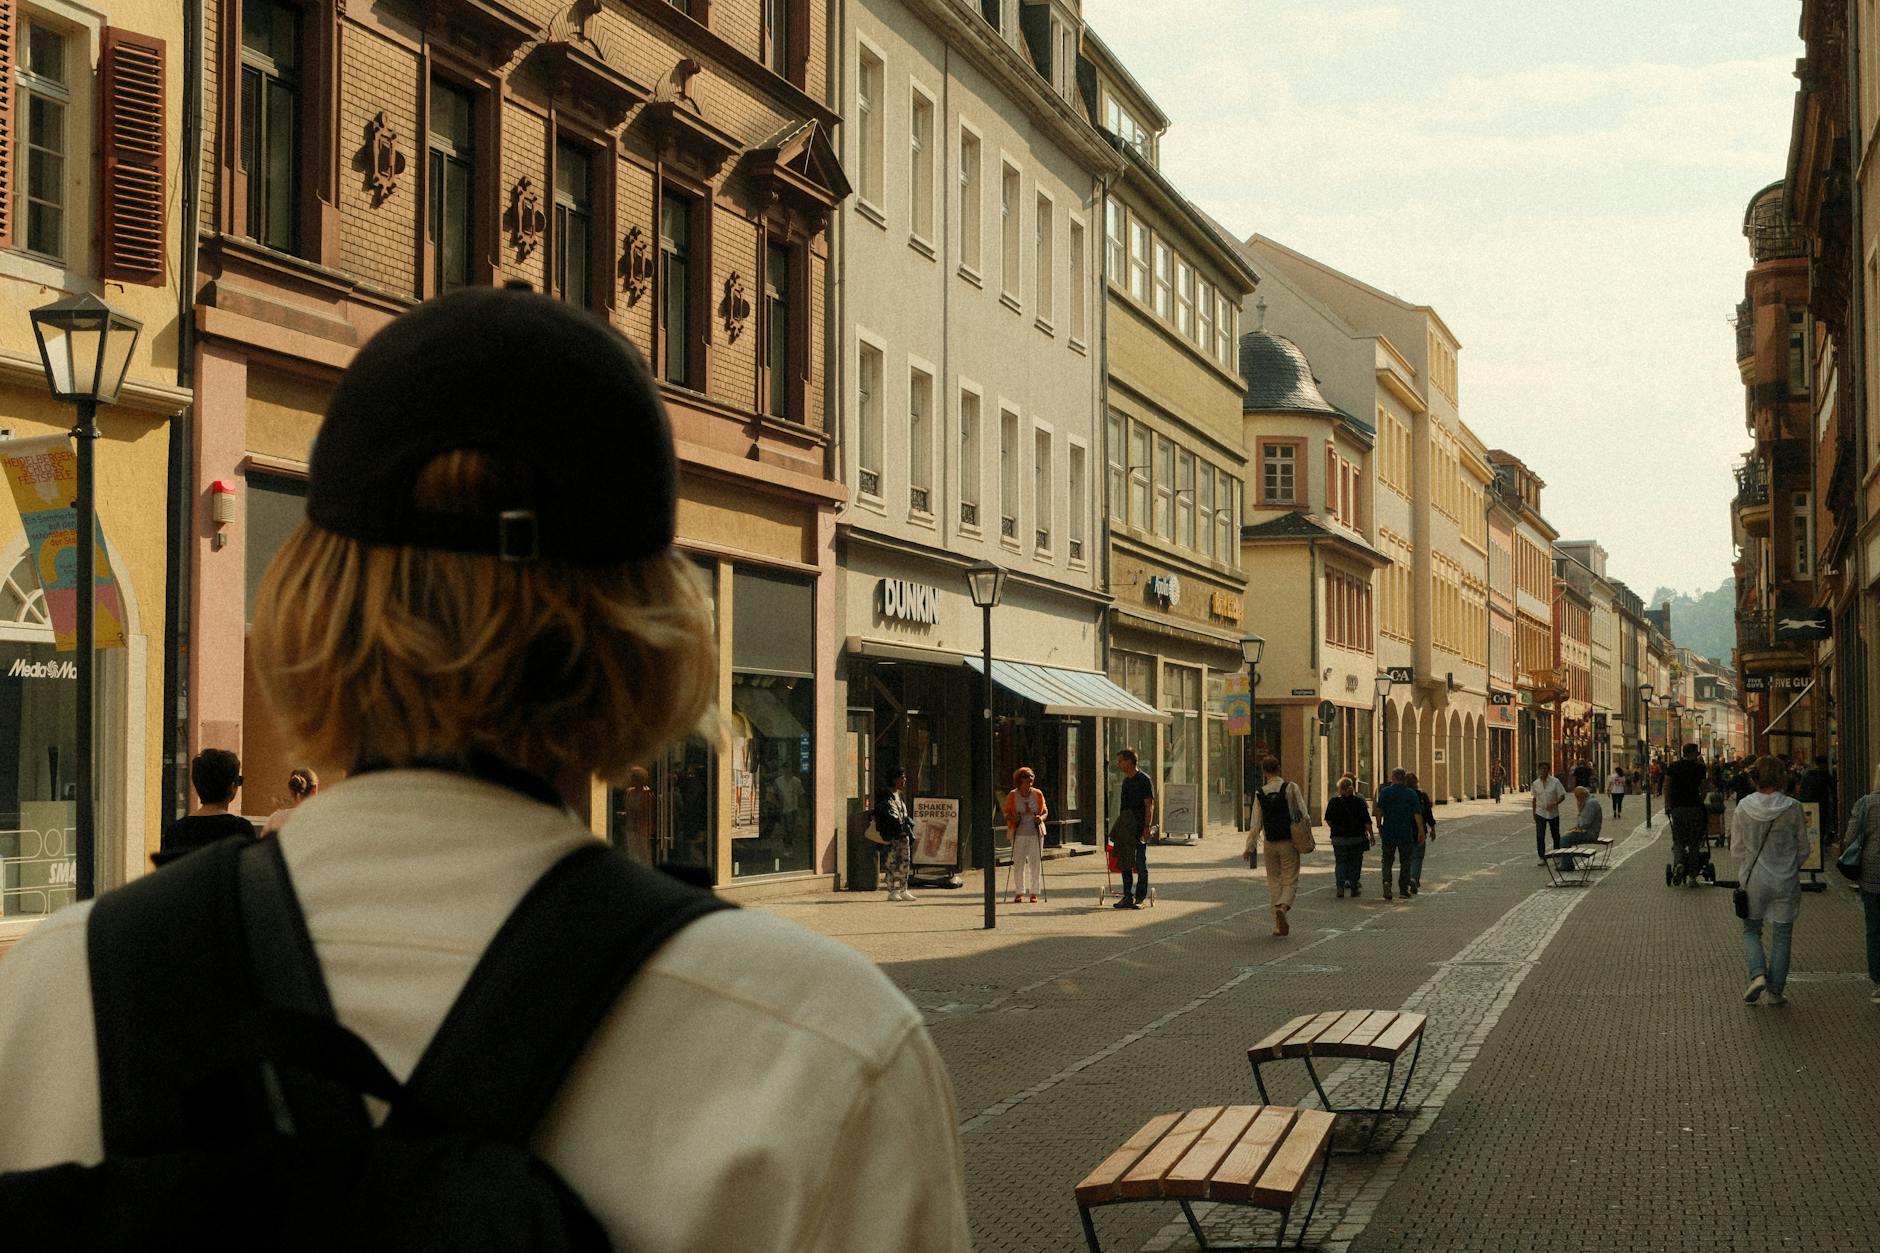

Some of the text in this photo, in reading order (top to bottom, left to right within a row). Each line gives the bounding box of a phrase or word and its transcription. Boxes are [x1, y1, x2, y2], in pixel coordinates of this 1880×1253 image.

[4, 452, 73, 467] HEIDELBERGER
[20, 461, 65, 476] SCHLOSS
[18, 470, 73, 485] FESTSPIELE
[884, 577, 940, 625] DUNKIN
[8, 658, 47, 678] Media
[914, 810, 957, 818] ESPRESSO
[918, 803, 953, 811] SHAKEN
